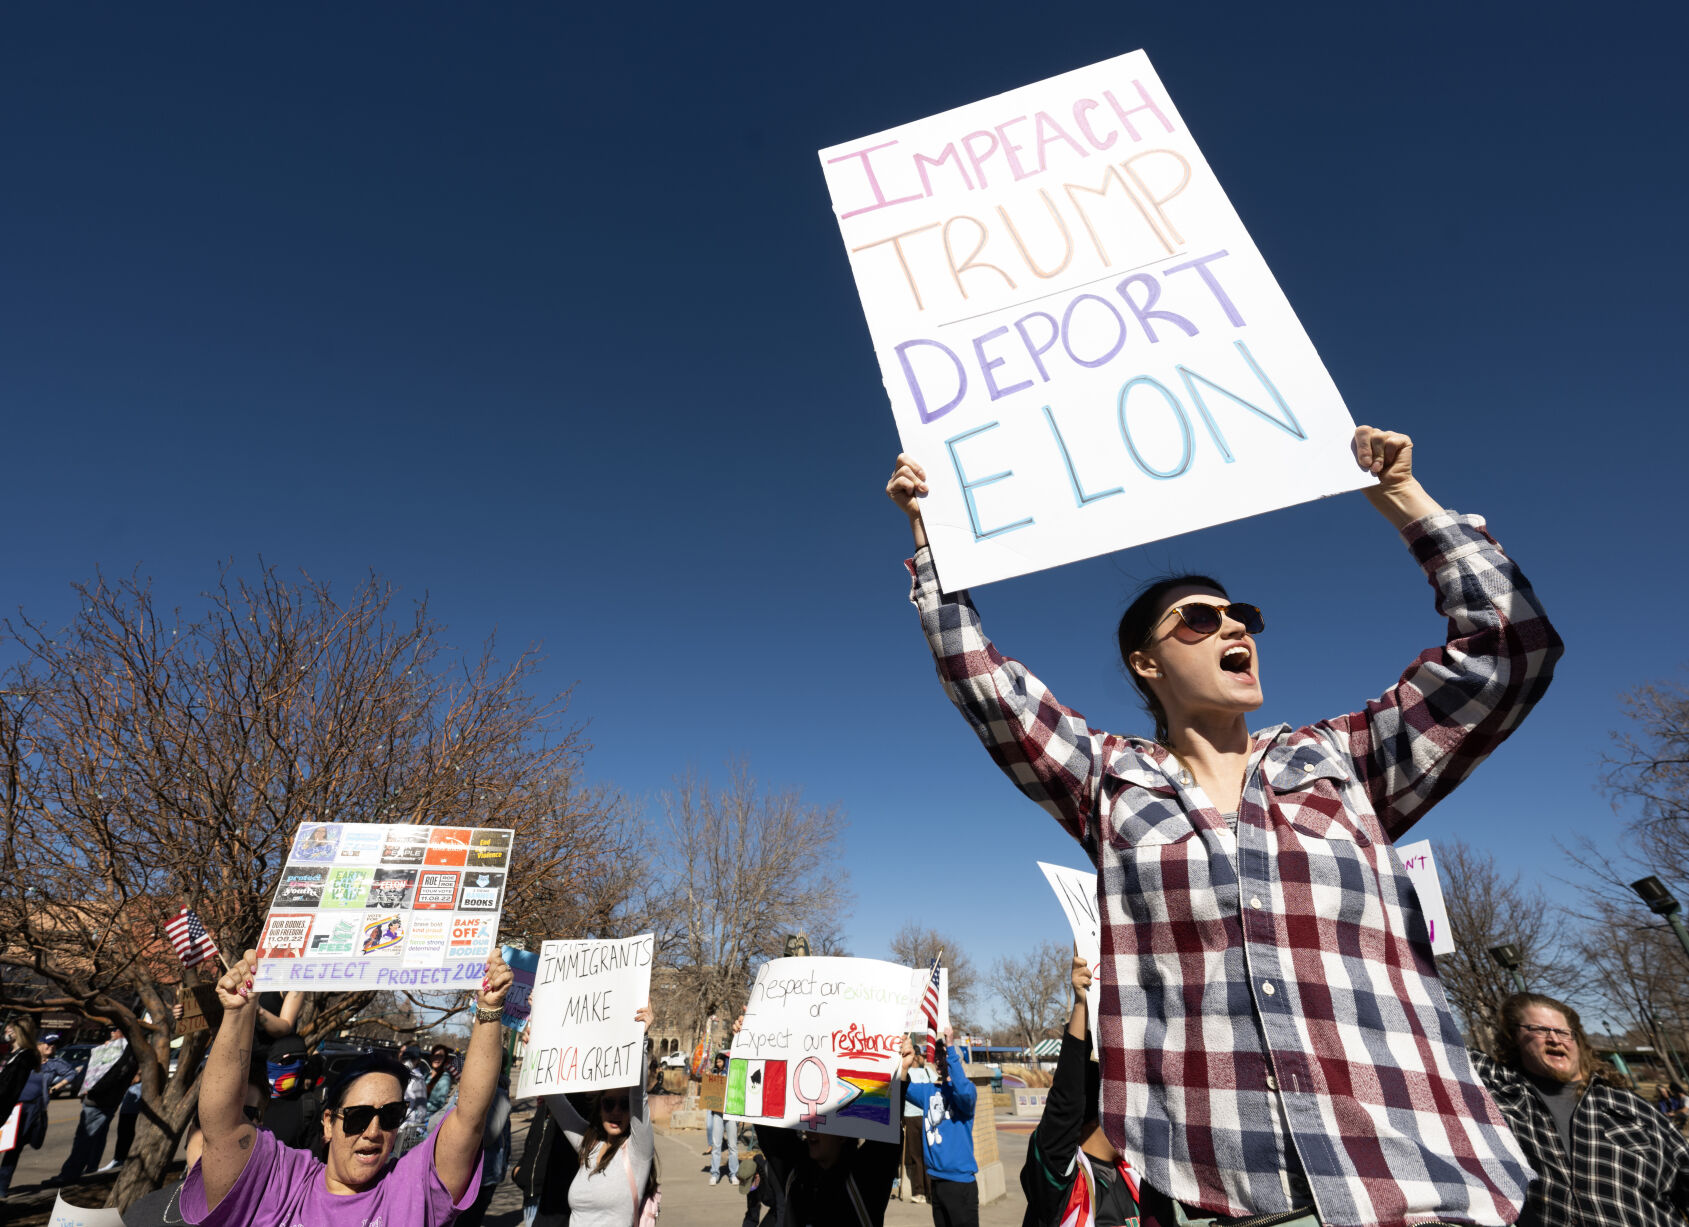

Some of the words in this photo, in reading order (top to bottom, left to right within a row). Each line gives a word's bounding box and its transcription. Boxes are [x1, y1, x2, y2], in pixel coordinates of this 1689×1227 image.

[827, 79, 1176, 220] IMPEACH
[851, 148, 1192, 312] TRUMP
[894, 249, 1246, 425] DEPORT
[944, 340, 1308, 543] ELON
[1405, 855, 1429, 871] N'T
[464, 898, 494, 907] BOOKS
[256, 963, 277, 981] I
[289, 960, 371, 980] REJECT
[376, 966, 452, 986] PROJECT
[540, 938, 653, 986] IMMIGRANTS
[820, 980, 846, 997] our
[561, 990, 613, 1027] MAKE
[809, 1001, 829, 1018] or
[803, 1033, 829, 1052] our
[519, 1046, 579, 1089] AMERICA
[581, 1041, 637, 1082] GREAT
